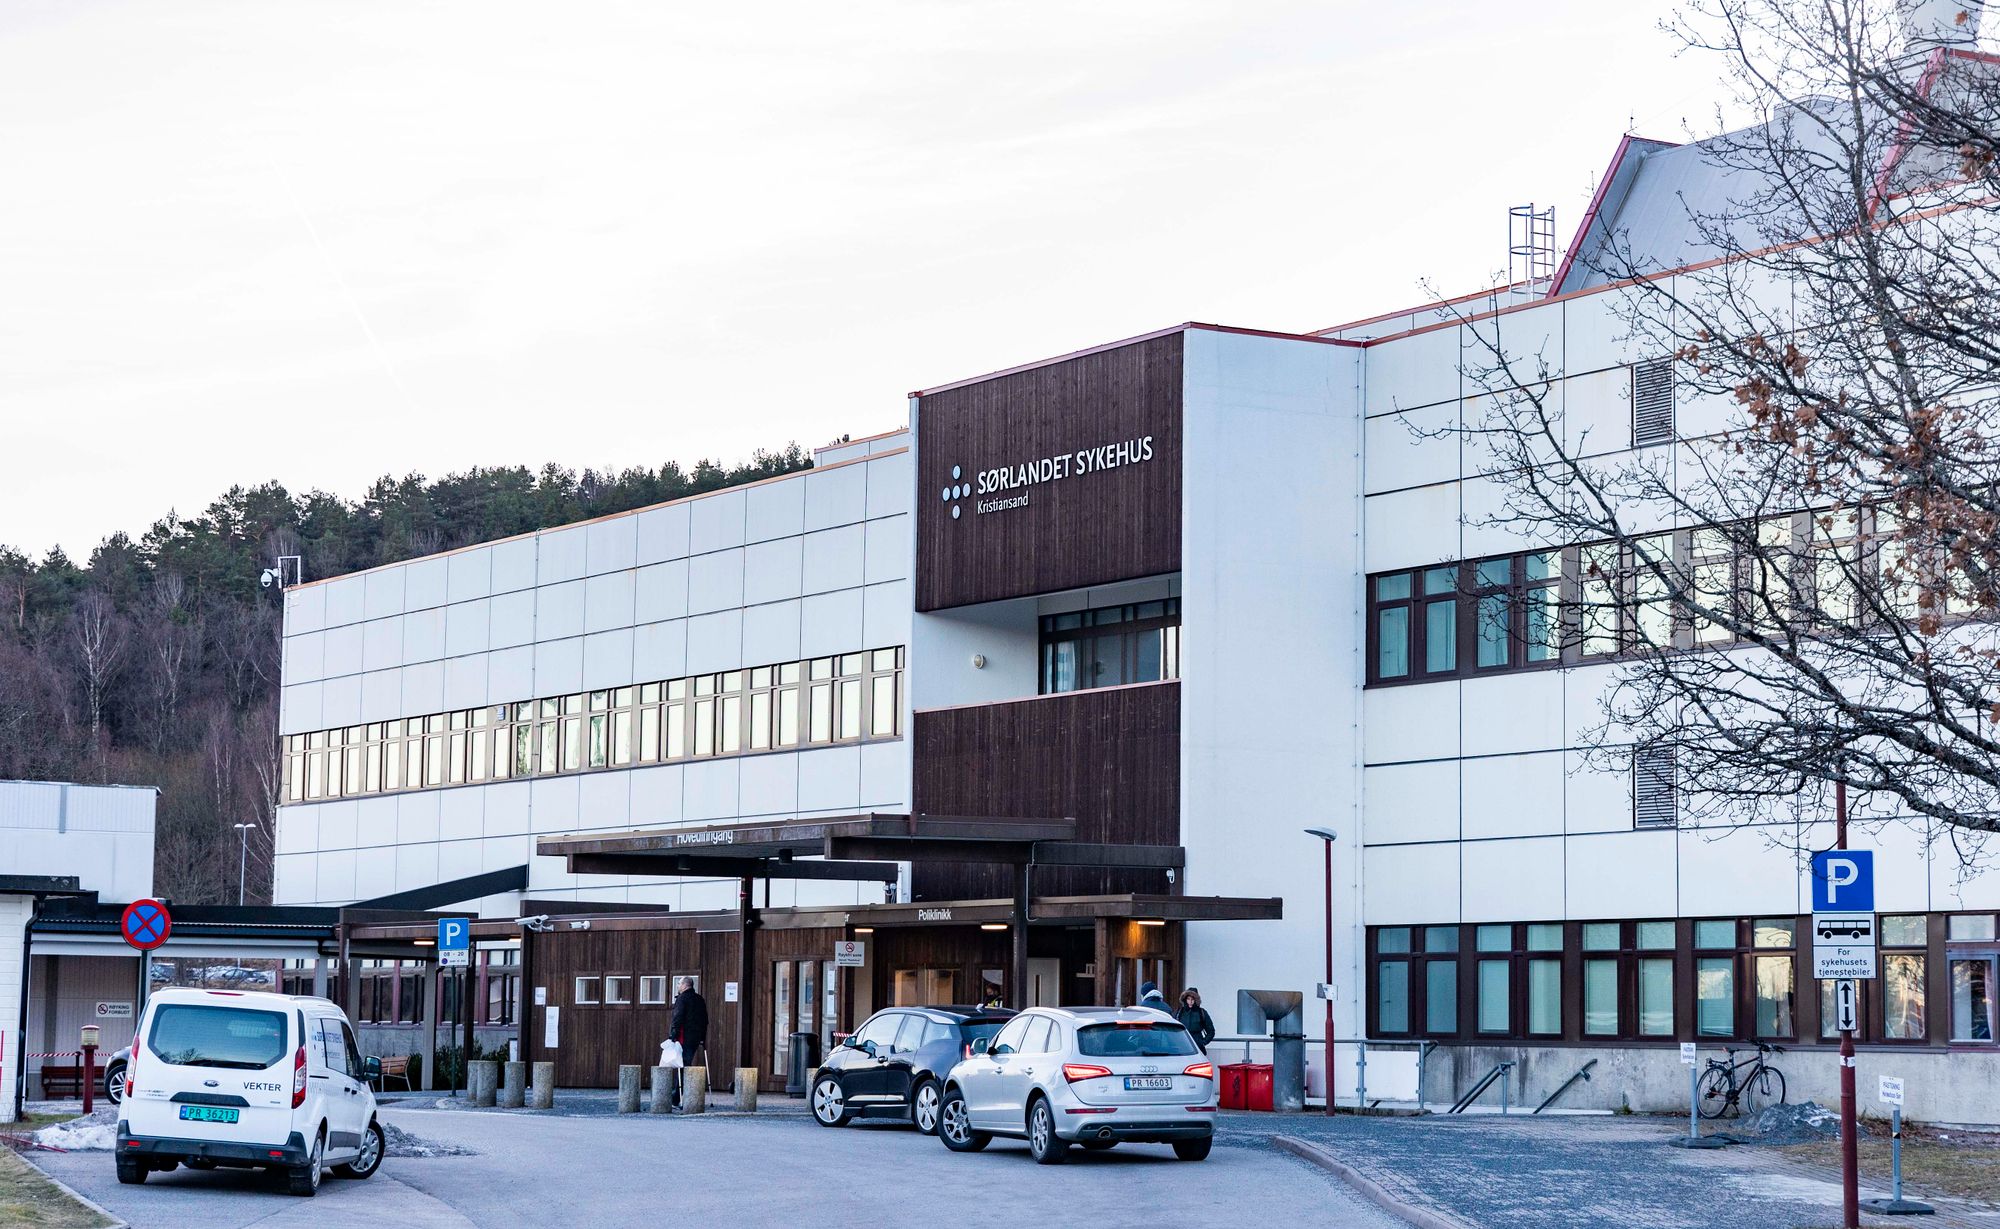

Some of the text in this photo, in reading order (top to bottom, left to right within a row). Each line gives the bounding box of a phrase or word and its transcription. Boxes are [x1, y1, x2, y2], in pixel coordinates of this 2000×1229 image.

[978, 436, 1153, 494] SØRLANDET SYKEHUS
[977, 490, 1029, 515] Kristiansand
[1826, 858, 1859, 904] P
[918, 908, 952, 921] Poliklinikk
[446, 922, 461, 946] P
[1837, 948, 1851, 956] For
[1821, 958, 1867, 968] sykehusets
[1819, 968, 1871, 978] tjenestebiler
[243, 1081, 282, 1092] VEKTER
[1131, 1079, 1169, 1087] PR 16603
[188, 1108, 235, 1120] PR 36213
